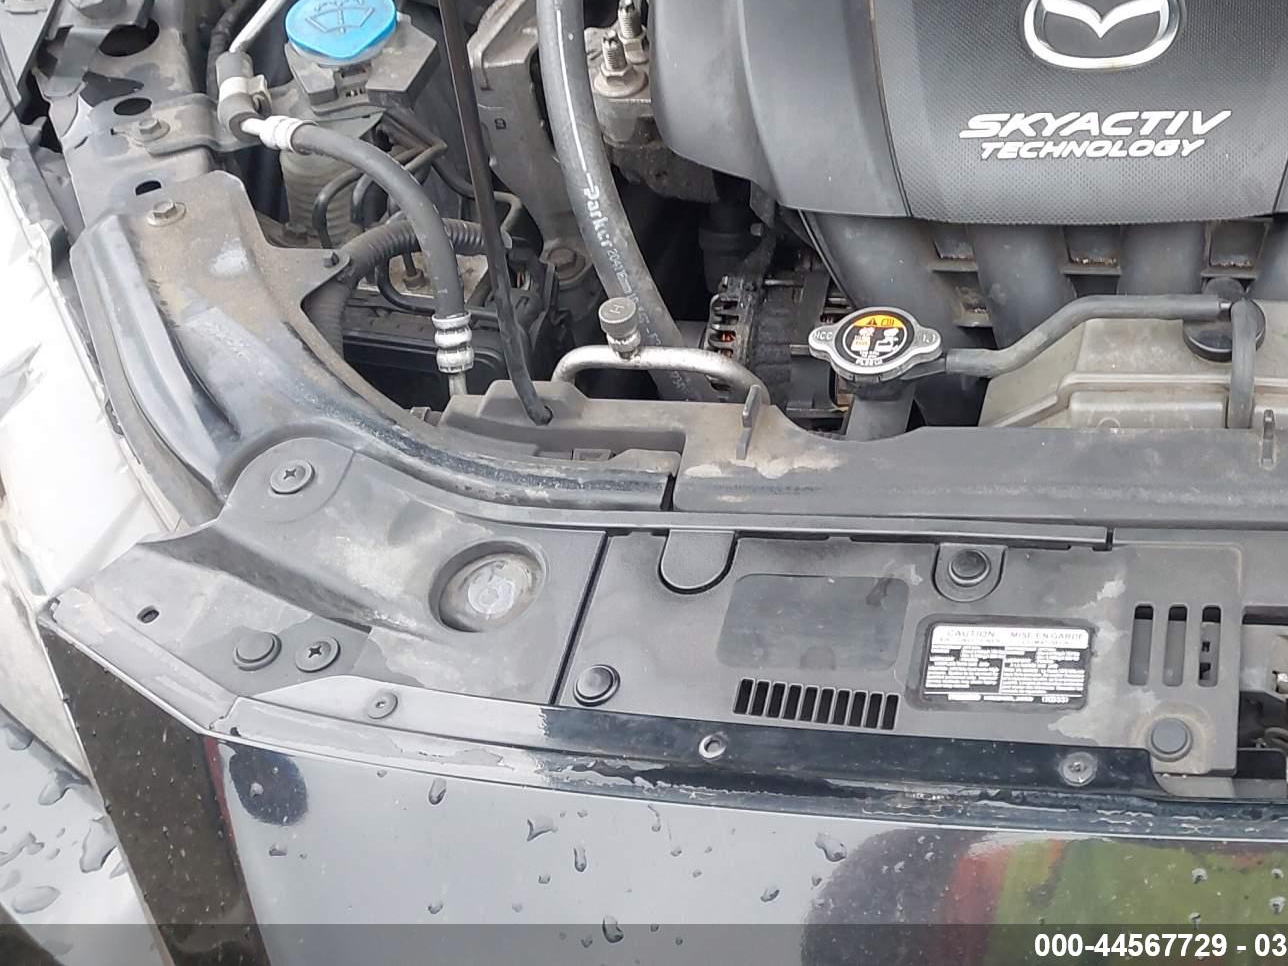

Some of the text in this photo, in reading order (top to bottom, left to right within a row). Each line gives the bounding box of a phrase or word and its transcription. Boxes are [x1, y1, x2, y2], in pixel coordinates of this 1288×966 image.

[959, 110, 1232, 139] SKYACTIV
[980, 139, 1205, 160] TECHNOLOGY
[583, 185, 613, 248] Parker
[947, 629, 995, 638] CAUTION
